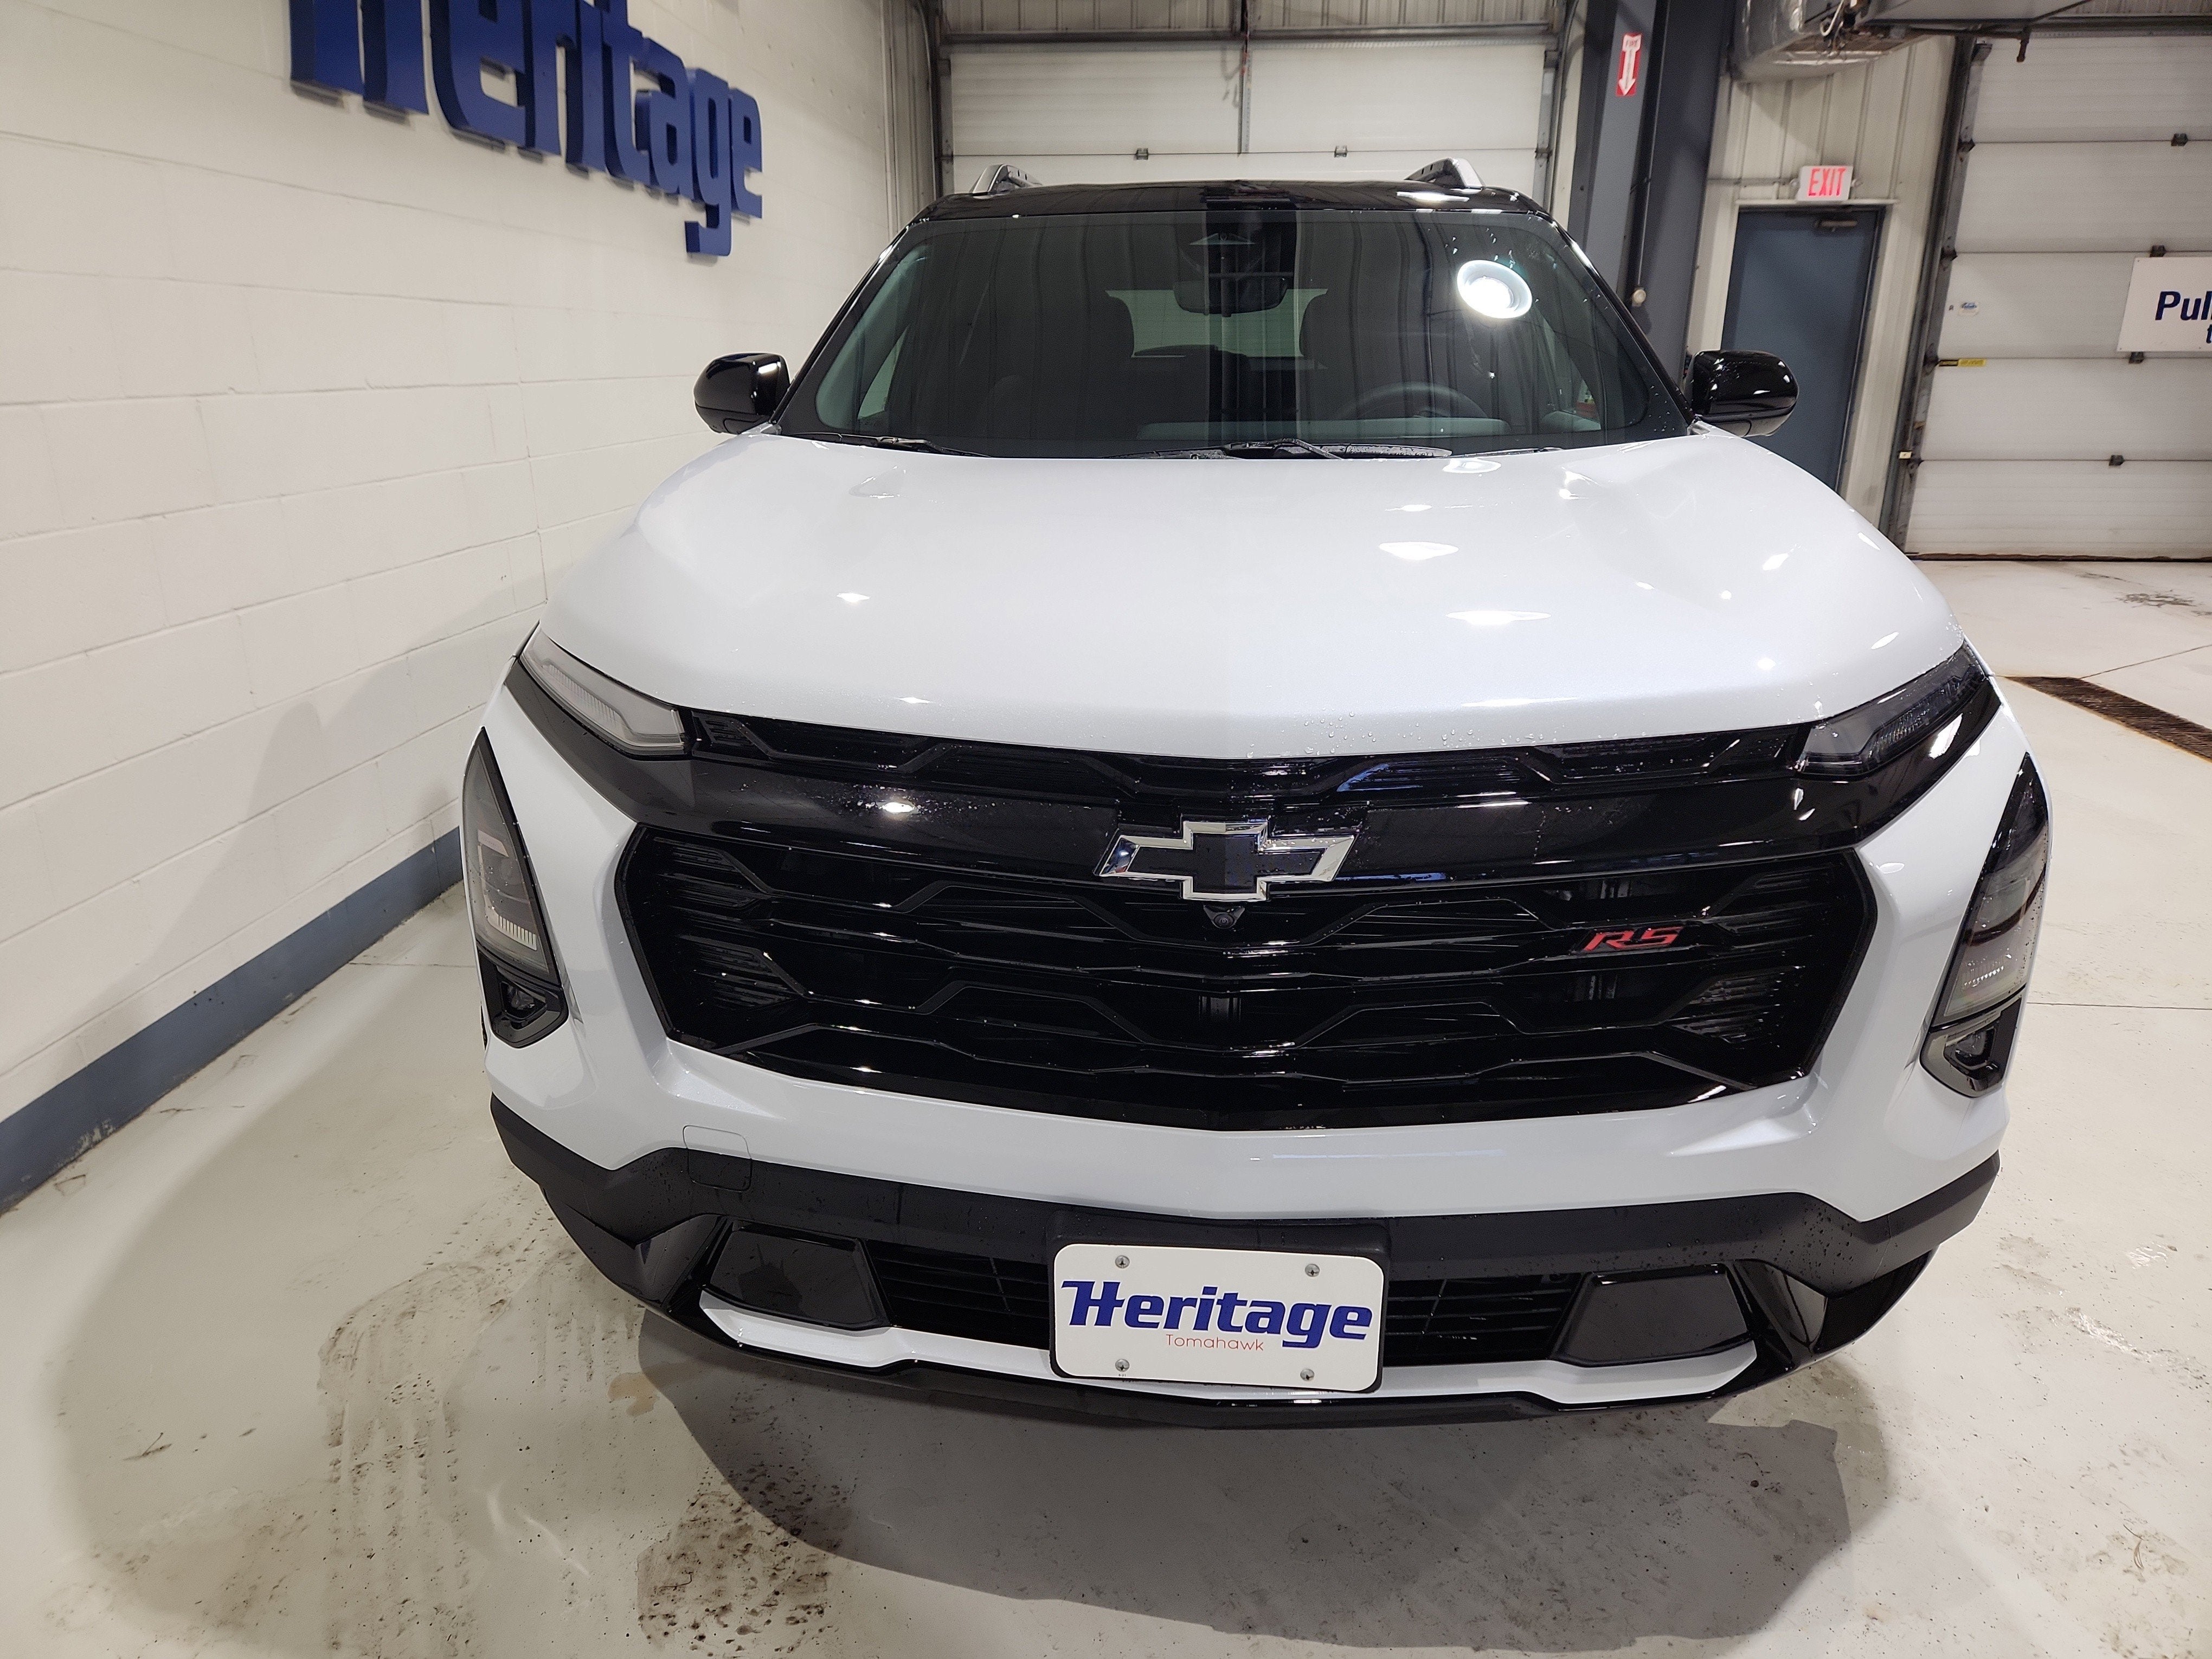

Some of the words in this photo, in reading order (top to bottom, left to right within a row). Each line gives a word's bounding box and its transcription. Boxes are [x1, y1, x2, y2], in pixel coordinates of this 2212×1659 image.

[1808, 168, 1847, 196] EXIT
[2155, 291, 2212, 320] Pul
[1583, 926, 1683, 951] RS
[1062, 1281, 1373, 1348] Heritage
[1166, 1334, 1264, 1351] Tomahawk
